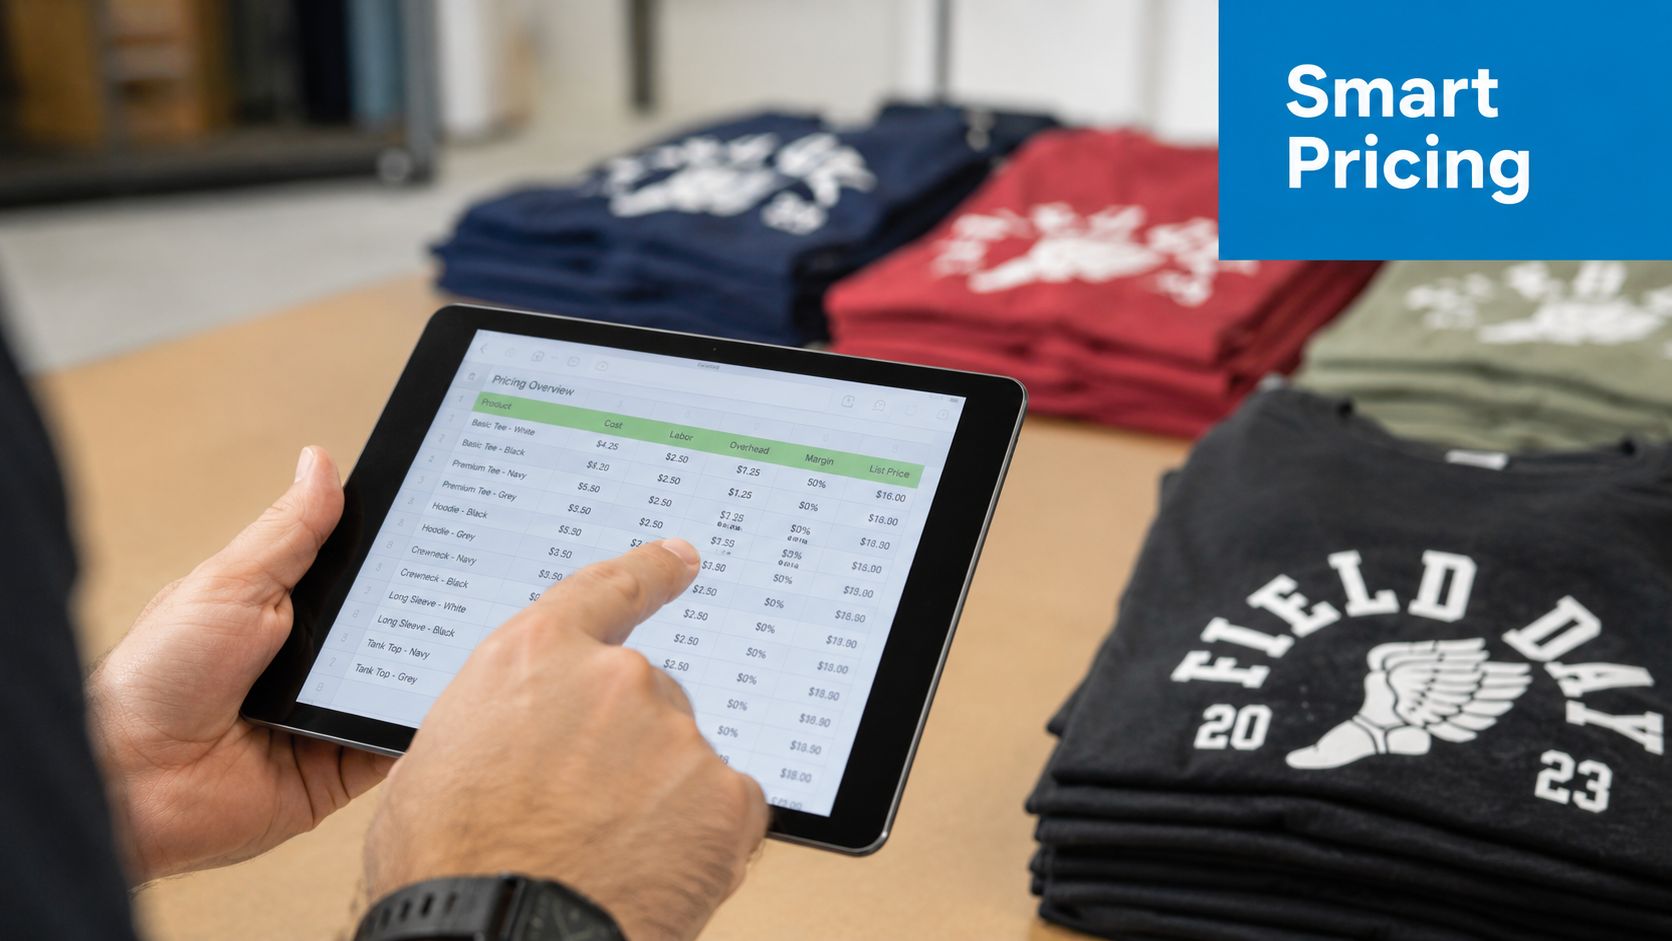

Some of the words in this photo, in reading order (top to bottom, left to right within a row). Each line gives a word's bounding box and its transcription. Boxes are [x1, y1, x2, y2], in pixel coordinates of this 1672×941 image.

[492, 374, 526, 390] Pricing
[528, 380, 575, 396] Overview
[481, 398, 512, 410] Product
[472, 418, 491, 429] Basic
[495, 422, 508, 432] Tee
[514, 426, 536, 436] White
[604, 420, 624, 430] Cost
[669, 430, 694, 442] Labor
[462, 438, 482, 448] Basic
[484, 442, 498, 452] Tee
[504, 446, 526, 456] Black
[729, 441, 770, 455] Overhead
[665, 452, 689, 464] $2.50
[805, 454, 834, 466] Margin
[452, 459, 486, 472] Premium
[488, 465, 500, 475] Tee
[507, 470, 527, 481] Navy
[869, 464, 885, 476] List
[886, 467, 910, 479] Price
[657, 474, 681, 485] $2.50
[442, 480, 476, 494] Premium
[478, 486, 492, 496] Tee
[498, 491, 517, 502] Grey
[875, 490, 906, 502] $16.00
[648, 496, 672, 507] $2.50
[432, 502, 460, 514] Hoodie
[466, 508, 488, 518] Black
[639, 518, 663, 529] $2.50
[422, 524, 450, 536] Hoodie
[456, 530, 476, 542] Grey
[412, 545, 450, 560] Crewneck
[456, 554, 477, 566] Navy
[400, 568, 439, 582] Crewneck
[446, 578, 469, 589] Black
[692, 584, 717, 596] $2.50
[388, 591, 409, 604] Long
[410, 596, 436, 607] Sleeve
[444, 602, 467, 613] White
[683, 609, 708, 621] $2.50
[377, 615, 398, 628] Long
[399, 619, 425, 631] Sleeve
[432, 626, 456, 637] Black
[674, 634, 699, 646] $2.50
[367, 639, 385, 650] Tank
[388, 643, 402, 654] Top
[409, 647, 430, 660] Navy
[1170, 549, 1478, 689] FIELD
[1502, 595, 1665, 755] DAY
[663, 659, 689, 672] $2.50
[355, 663, 374, 675] Tank
[376, 667, 390, 678] Top
[398, 672, 418, 685] Grey
[1193, 703, 1273, 751] 20
[1534, 749, 1614, 813] 23
